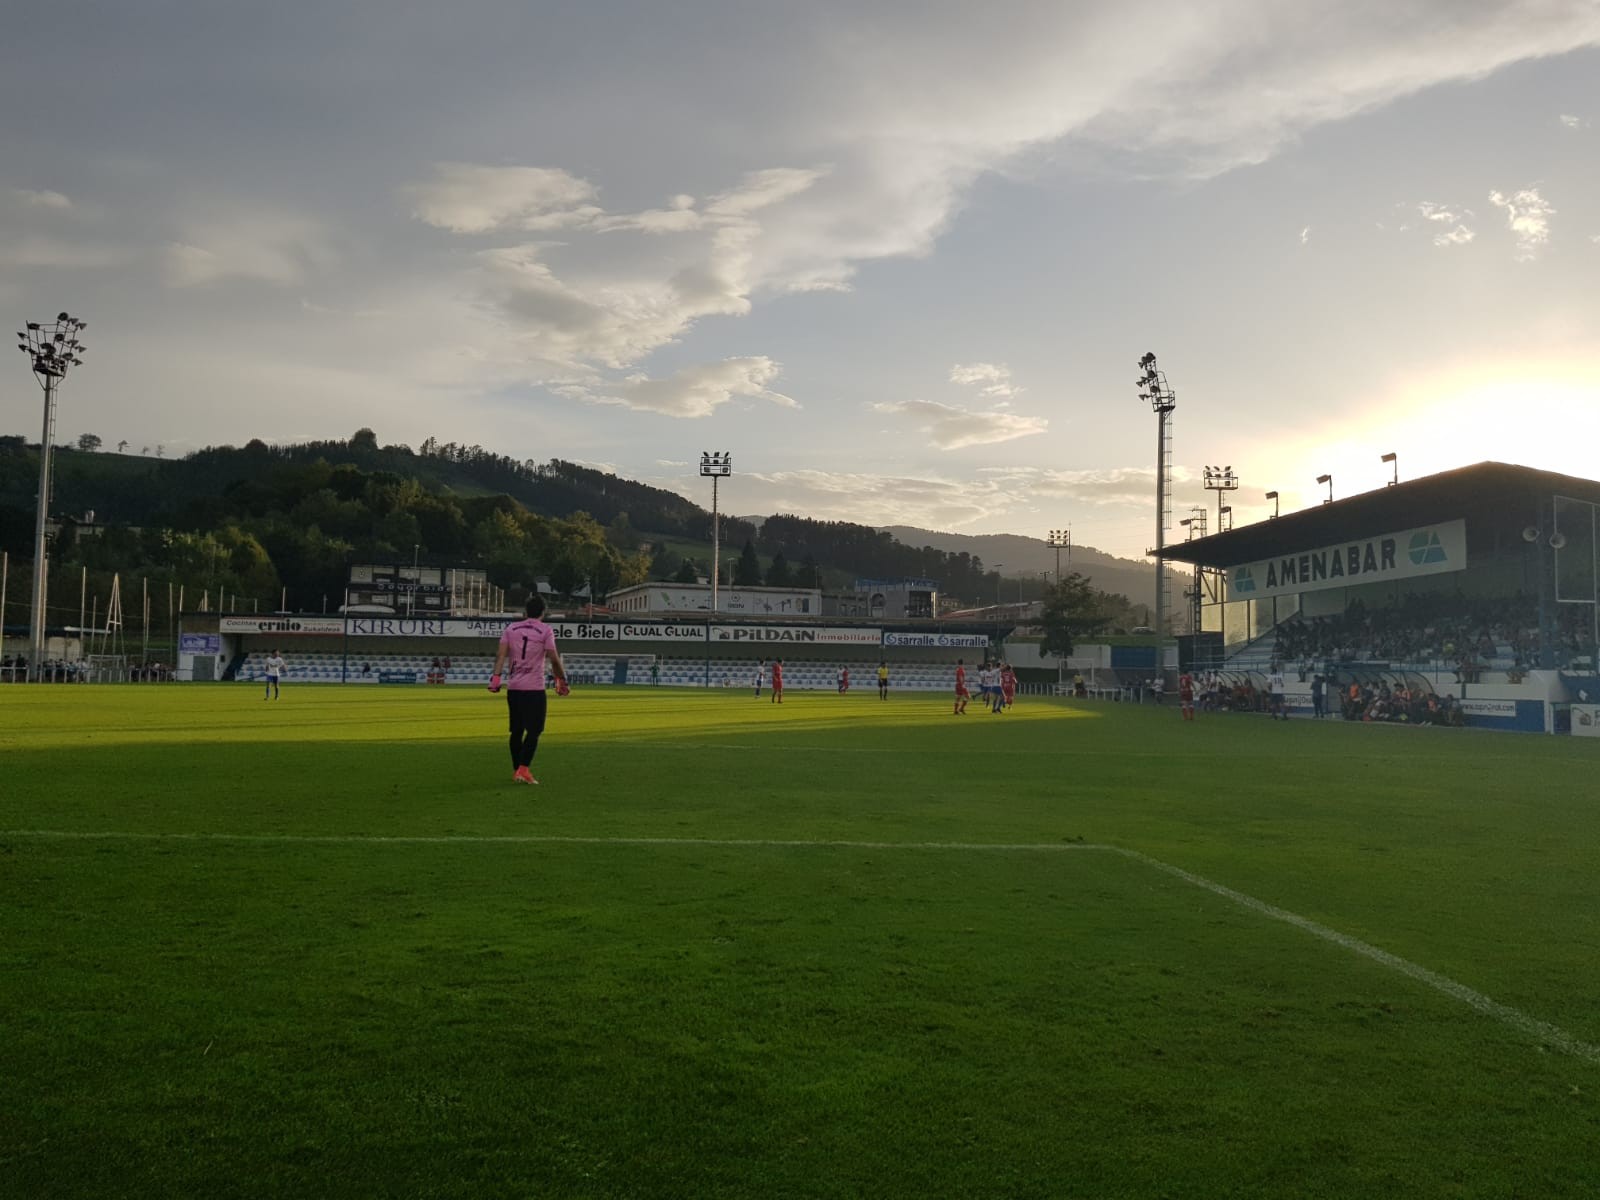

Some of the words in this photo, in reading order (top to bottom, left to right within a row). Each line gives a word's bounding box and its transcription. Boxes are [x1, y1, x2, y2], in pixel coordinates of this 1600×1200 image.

[1266, 538, 1396, 588] AMENABAR
[259, 619, 301, 631] ernio
[352, 619, 449, 635] KIRURI
[578, 625, 615, 639] Biele
[624, 626, 662, 637] GLUAL
[665, 626, 704, 637] GLUAL
[522, 636, 529, 660] 1
